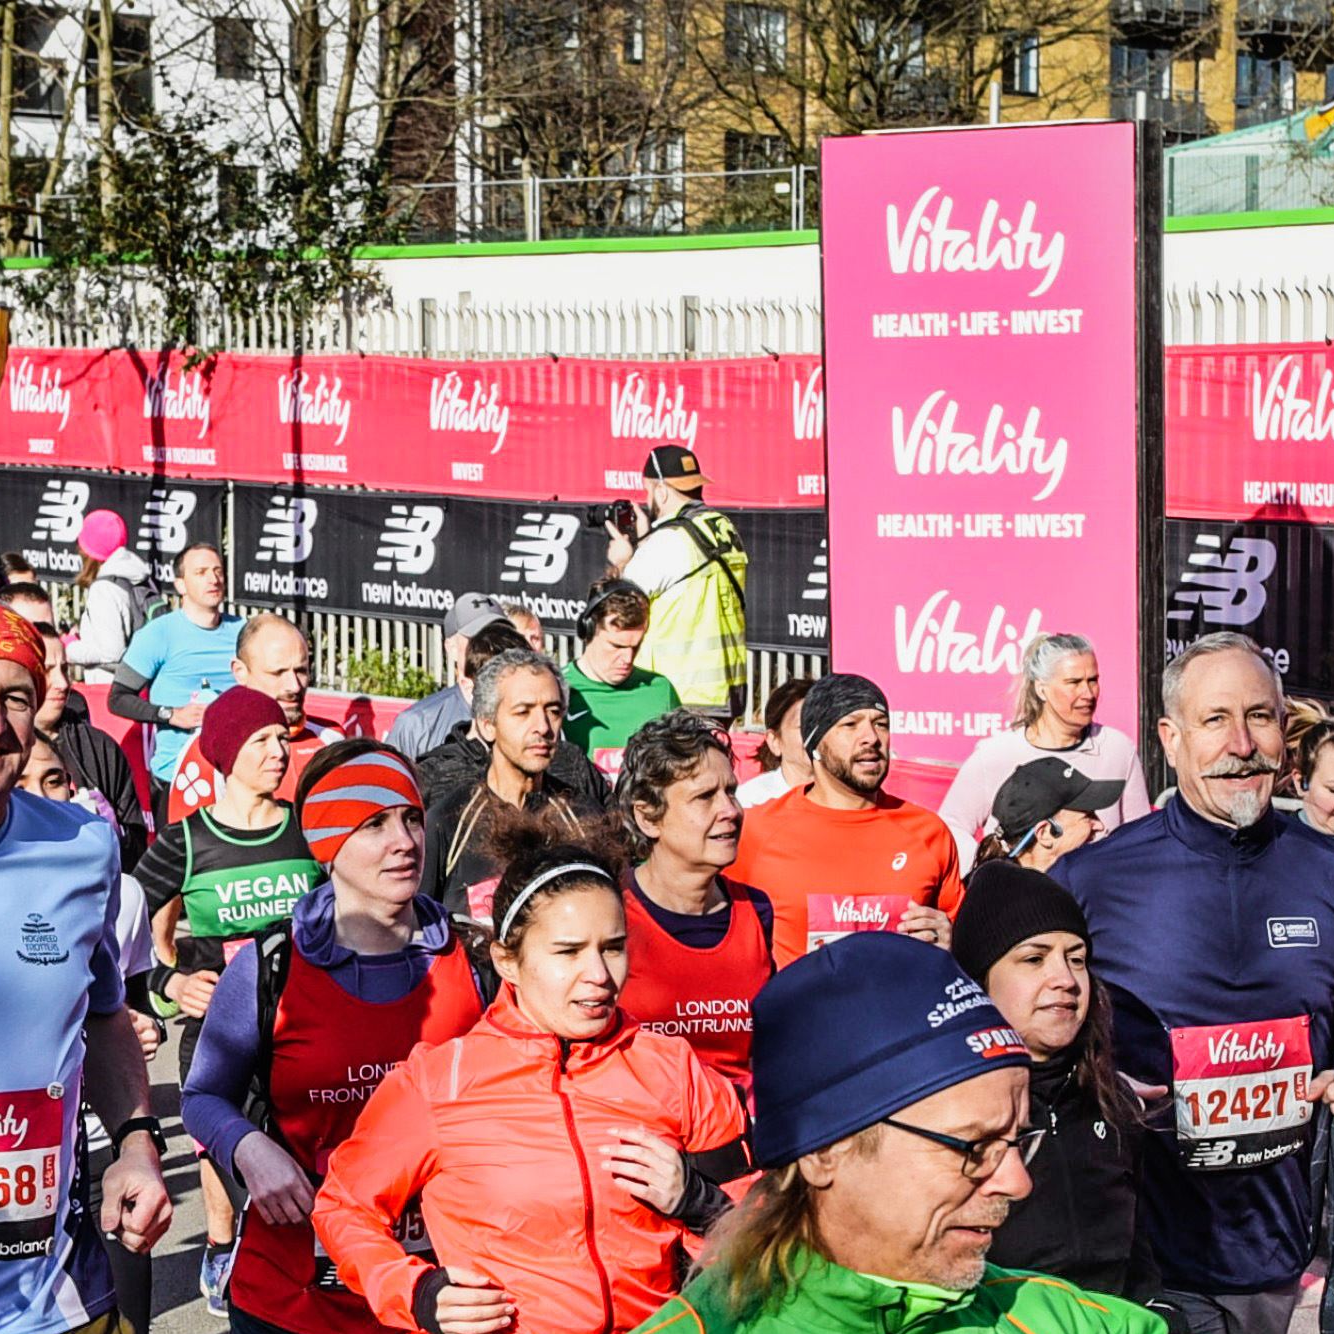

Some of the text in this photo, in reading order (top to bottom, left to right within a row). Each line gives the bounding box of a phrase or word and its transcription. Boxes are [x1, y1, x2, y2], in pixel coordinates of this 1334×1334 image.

[886, 185, 1065, 297] Vitality
[872, 308, 1083, 338] HEALTH LIFE INVEST
[10, 355, 71, 431] Vitality
[143, 364, 211, 440] Vitality
[278, 368, 351, 447] Vitality
[429, 371, 509, 454] Vitality
[610, 371, 698, 452] Vitality
[142, 446, 217, 466] HEALTH INSURANCE
[892, 389, 1068, 501] Vitality
[282, 453, 348, 473] LIFE INSURANCE
[451, 461, 484, 482] INVEST
[1243, 480, 1296, 506] HEALTH
[877, 513, 1085, 537] HEALTH LIFE INVEST
[22, 547, 46, 569] new
[244, 569, 328, 600] new balance
[362, 580, 455, 611] new balance
[894, 589, 1043, 675] Vitalit
[963, 712, 1002, 736] LIFE
[214, 872, 310, 904] VEGAN
[832, 895, 890, 930] Vitality
[675, 999, 749, 1017] LONDON
[1208, 1028, 1286, 1068] Vitality
[1184, 1081, 1289, 1127] 12427
[1237, 1150, 1262, 1165] new
